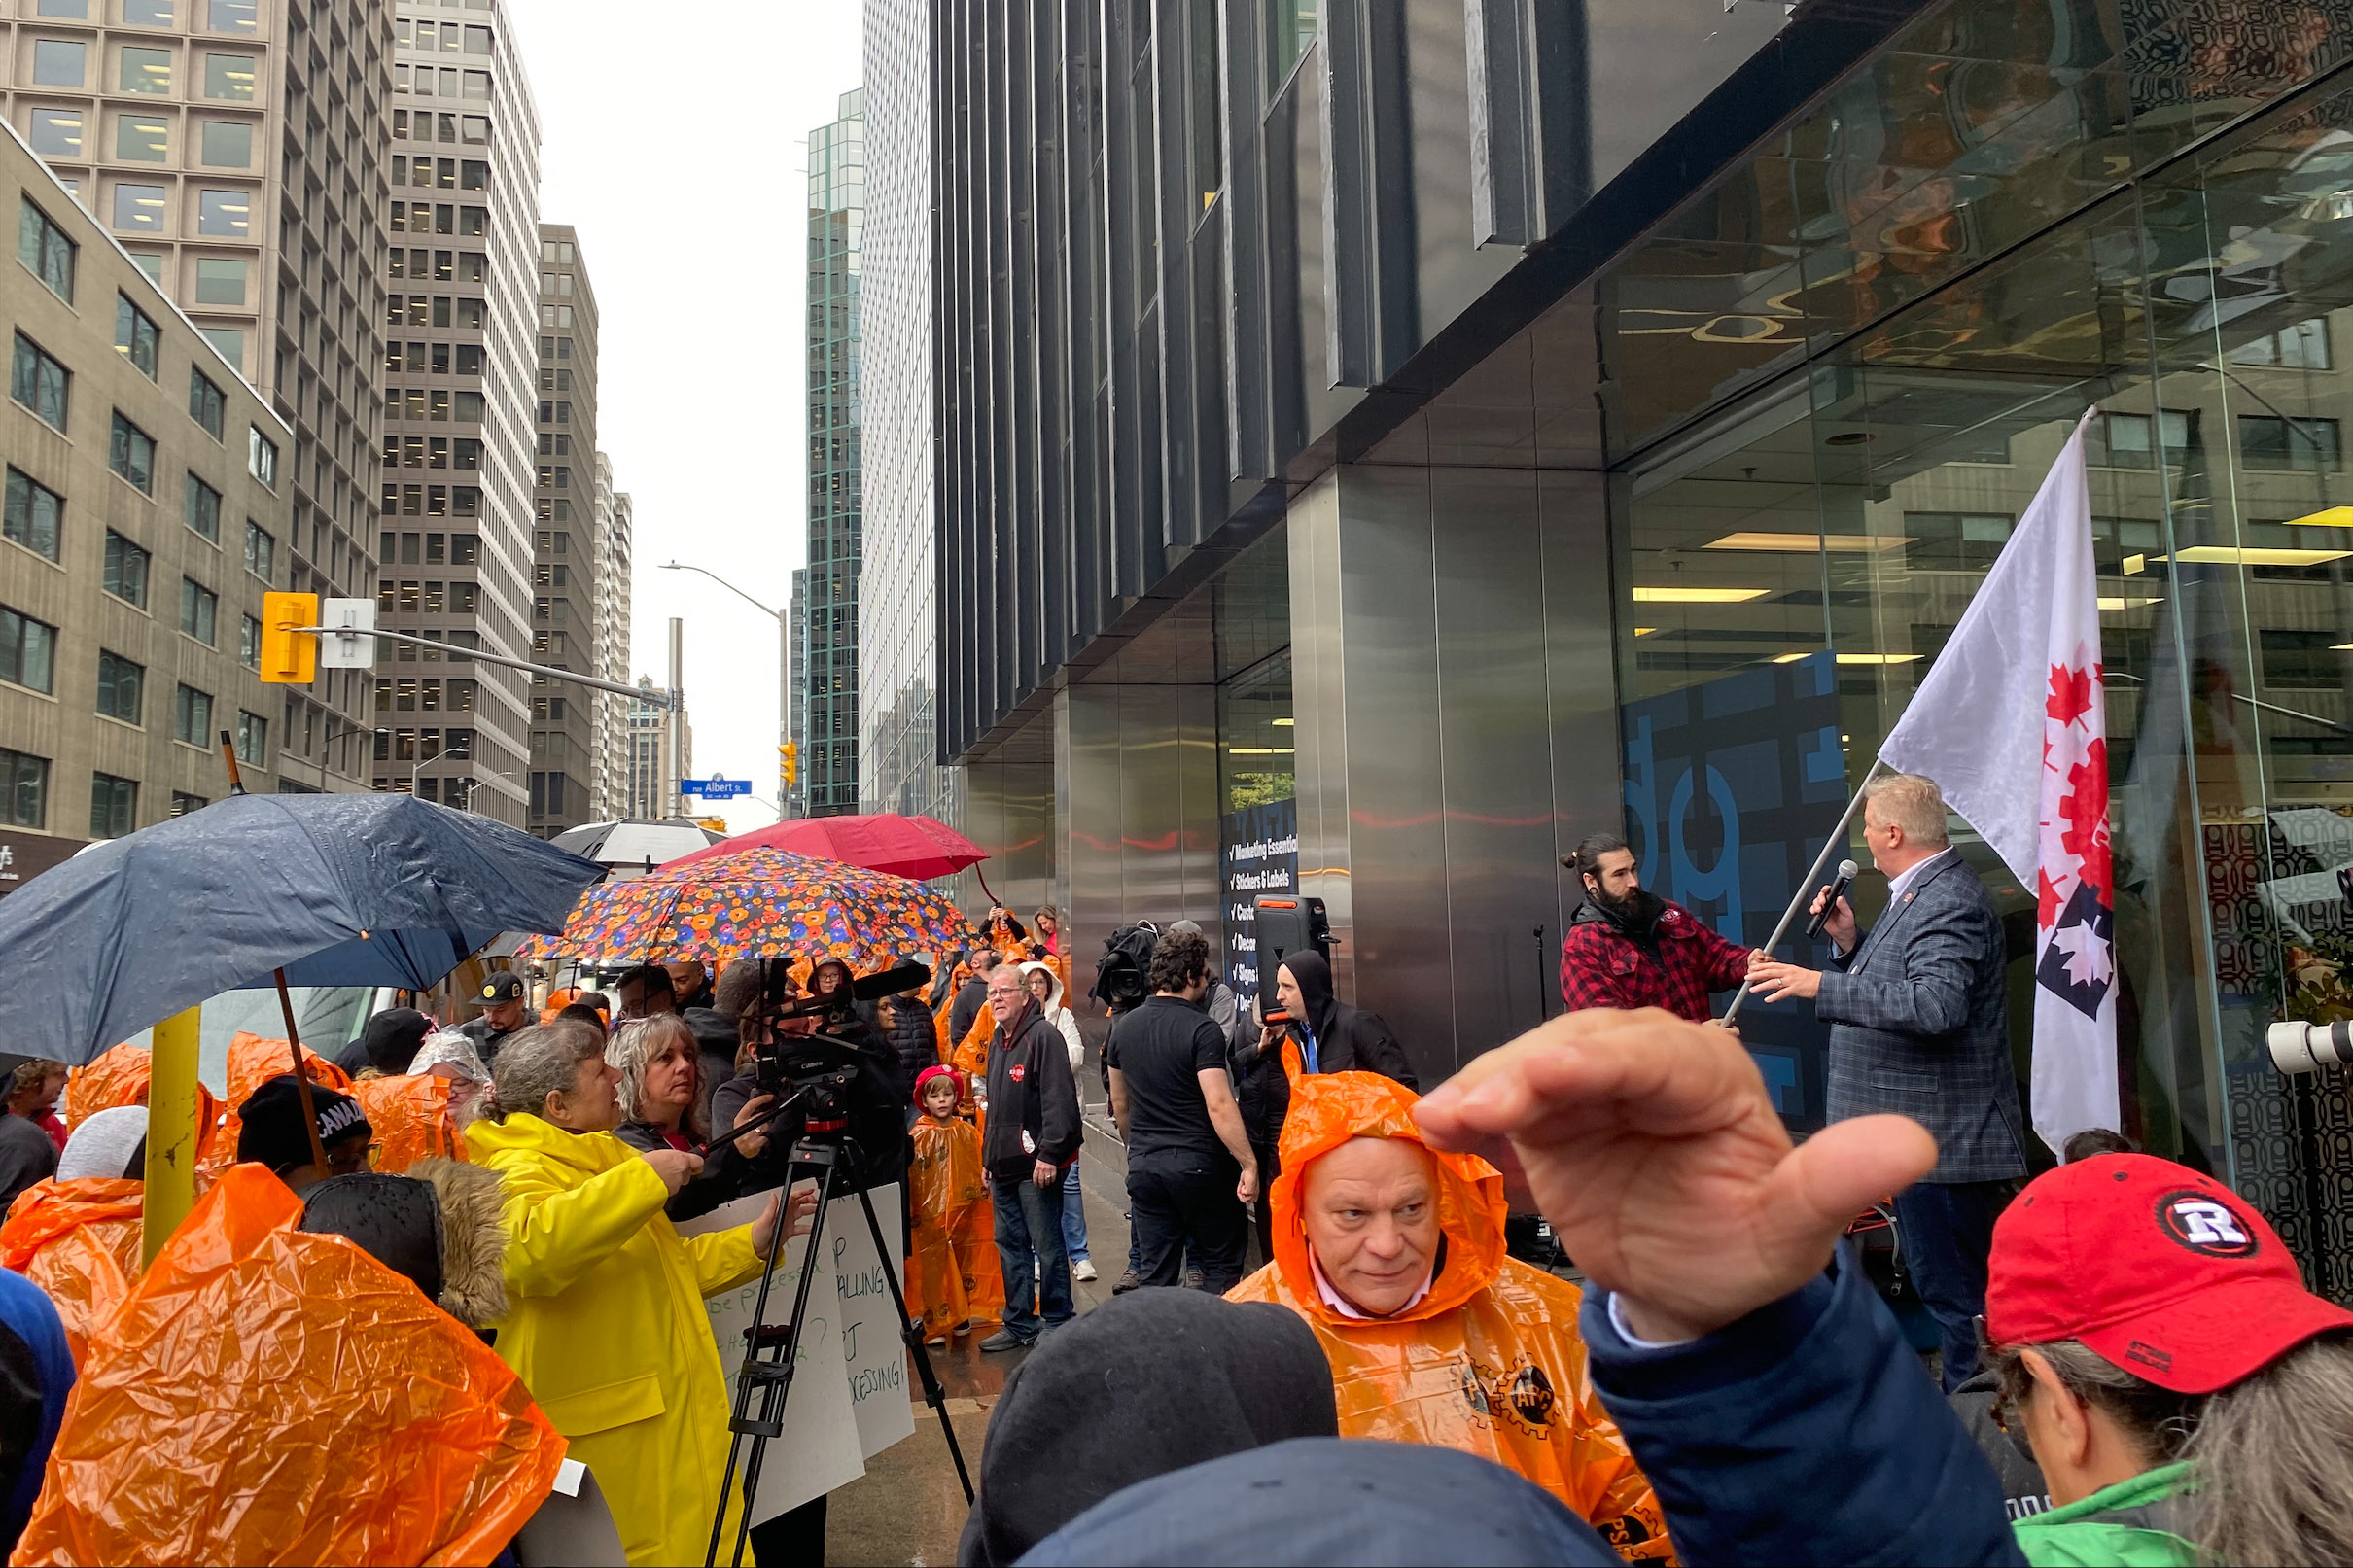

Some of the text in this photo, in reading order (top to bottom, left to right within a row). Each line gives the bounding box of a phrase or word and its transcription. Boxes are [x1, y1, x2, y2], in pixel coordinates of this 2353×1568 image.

[705, 782, 733, 792] Albert
[1235, 839, 1268, 861] Marketing
[1235, 867, 1290, 891] Stickers & Labels
[1239, 963, 1256, 987] Signs
[2173, 1202, 2247, 1243] R
